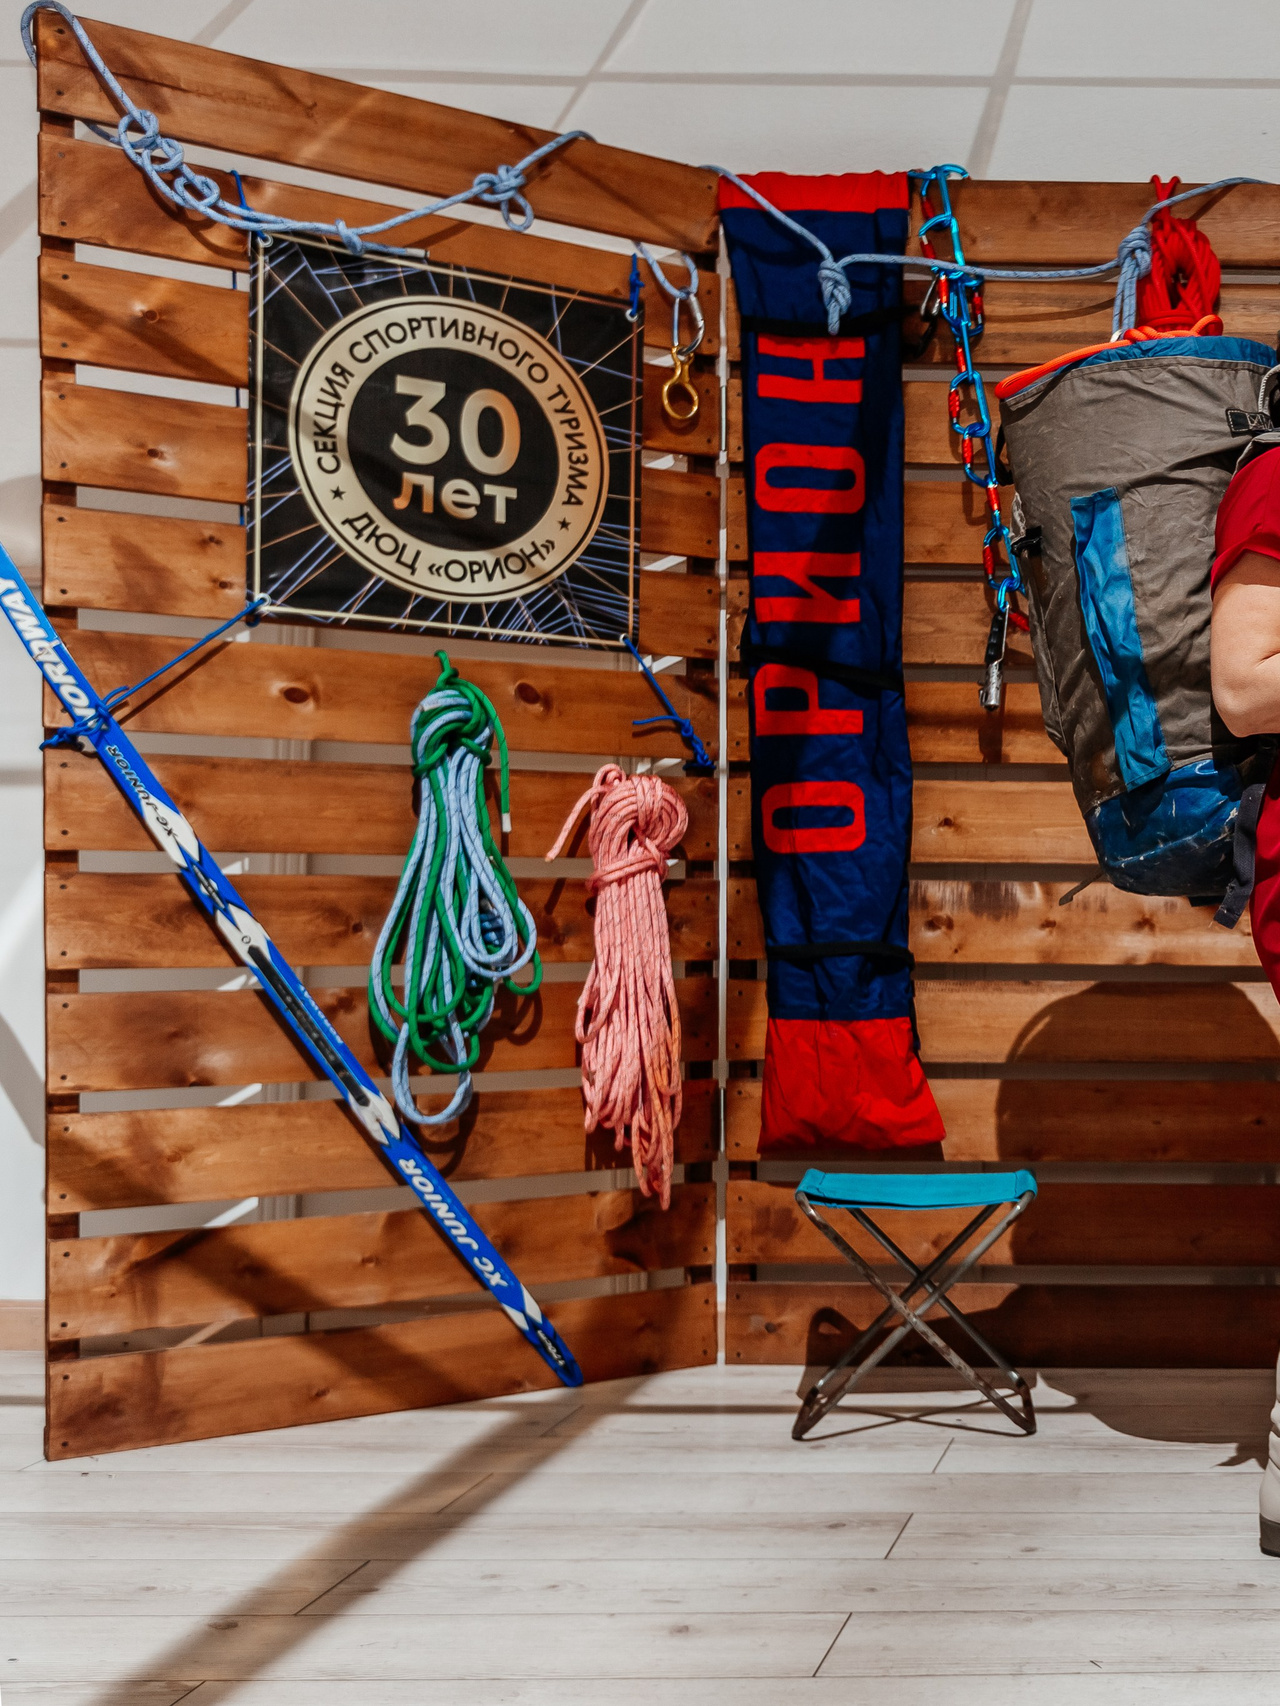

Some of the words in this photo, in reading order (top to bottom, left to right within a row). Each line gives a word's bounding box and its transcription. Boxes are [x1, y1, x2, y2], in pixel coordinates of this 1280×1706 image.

[313, 361, 355, 474] СЕКЦИЯ
[348, 315, 550, 384] СПОРТИВНОГО
[546, 384, 589, 507] ТУРИЗМА
[390, 374, 521, 477] 30
[393, 471, 518, 525] лет
[341, 511, 422, 576] ДЮЦ
[428, 538, 556, 584] «ОРИОН»
[753, 334, 867, 854] ОРИОН
[105, 744, 159, 813] JUNIOR
[397, 1157, 480, 1252] JUNIOR
[472, 1255, 509, 1289] XC
